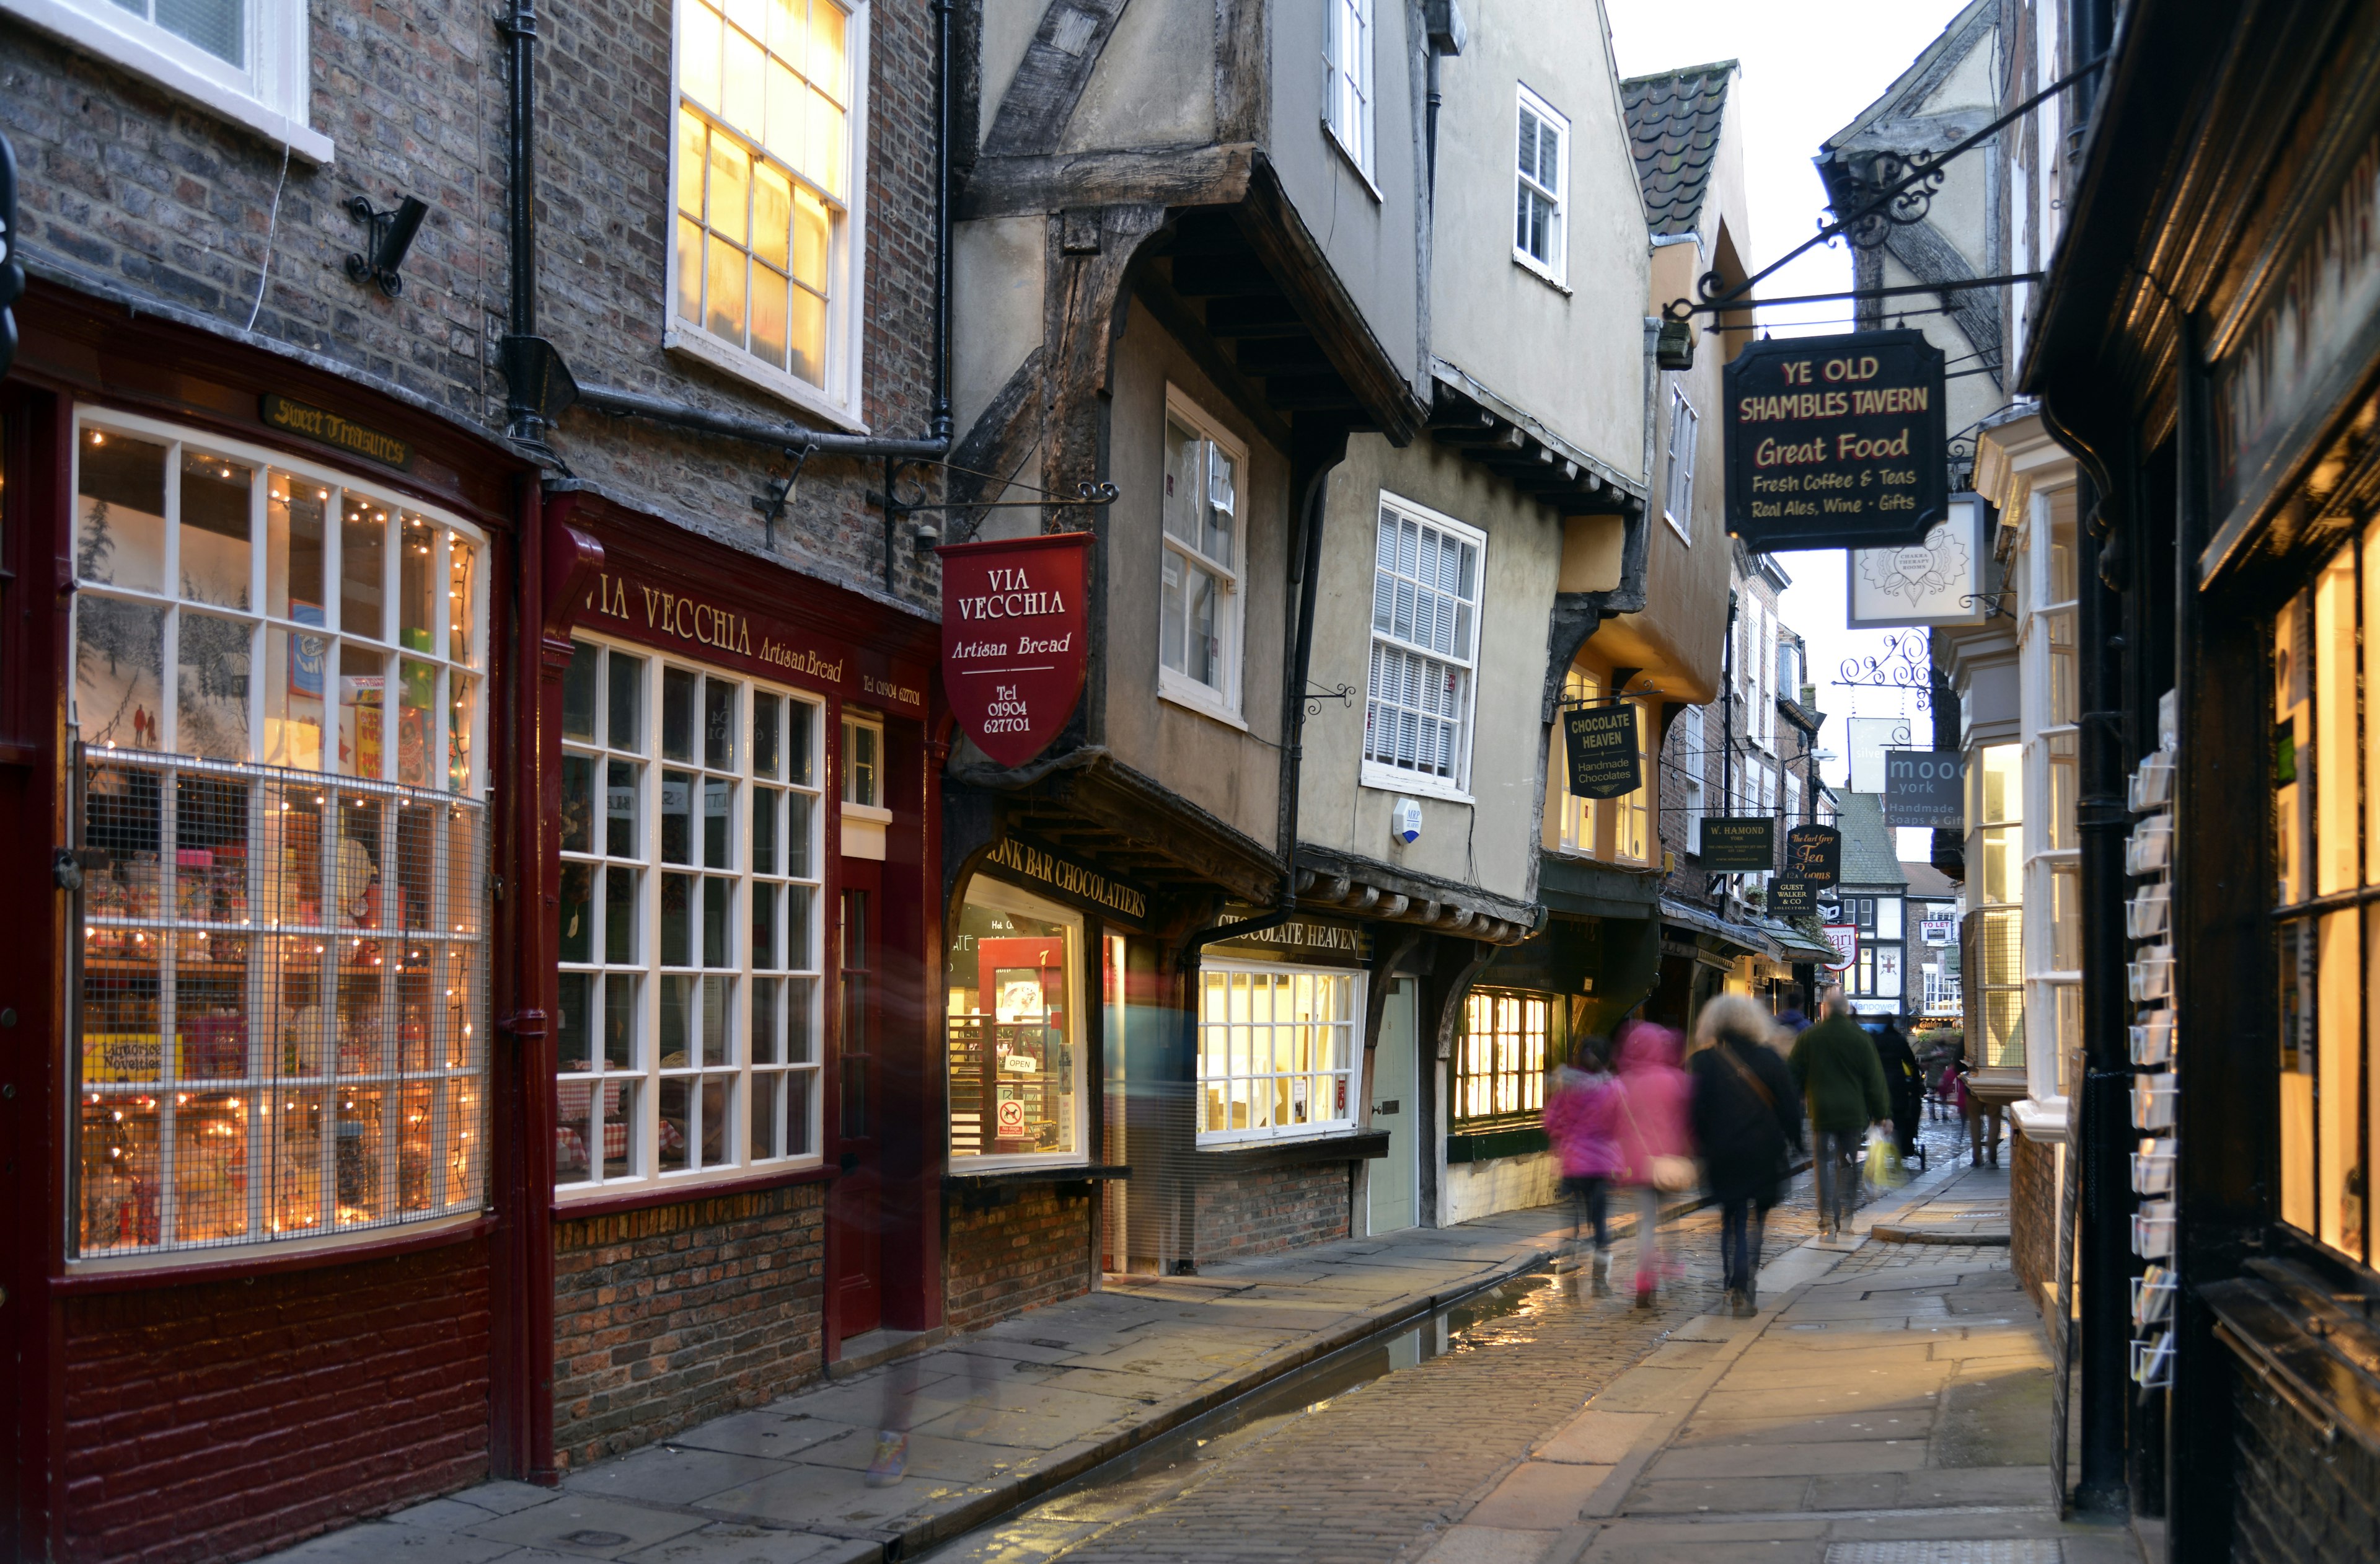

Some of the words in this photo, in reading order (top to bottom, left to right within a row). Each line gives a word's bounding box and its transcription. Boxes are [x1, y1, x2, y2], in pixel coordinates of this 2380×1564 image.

[1782, 361, 1812, 385] YE
[1822, 357, 1879, 381] OLD
[1740, 391, 1848, 423] SHAMBLES
[1852, 387, 1928, 415] TAVERN
[274, 399, 323, 435] Sweet
[325, 414, 405, 464] Treasures
[1755, 436, 1828, 468] Great
[1838, 428, 1910, 460] Food
[1752, 475, 1799, 492] Fresh
[1804, 473, 1853, 490] Coffee
[1861, 469, 1872, 487] &
[1879, 469, 1917, 485] Teas
[1752, 501, 1781, 518] Real
[1784, 500, 1819, 516] Ales,
[1823, 498, 1862, 513] Wine
[1879, 493, 1916, 511] Gifts
[988, 568, 1029, 592] VIA
[958, 591, 1065, 620] VECCHIA
[586, 573, 629, 619] IA
[643, 585, 752, 656] VECCHIA
[759, 637, 804, 671] Artisan
[805, 649, 844, 683] Bread
[951, 641, 1007, 658] Artisan
[1017, 632, 1072, 655] Bread
[863, 674, 874, 692] Tel
[876, 681, 897, 699] 01904
[899, 687, 920, 706] 627701
[997, 684, 1017, 702] Tel
[988, 700, 1027, 717] 01904
[984, 718, 1031, 733] 627701
[1571, 713, 1630, 733] CHOCOLATE
[1582, 731, 1622, 749] HEAVEN
[1578, 758, 1629, 772] Handmade
[1579, 771, 1631, 784] Chocolates
[1408, 810, 1420, 820] MRP
[1889, 803, 1954, 813] Handmade
[1889, 815, 1924, 826] Soaps
[1930, 816, 1938, 824] &
[1711, 826, 1721, 834] W.
[1724, 826, 1764, 834] HAMOND
[1791, 833, 1802, 842] The
[1804, 833, 1817, 842] Earl
[1818, 834, 1834, 844] Grey
[1796, 842, 1825, 864] Tea
[1025, 846, 1052, 883] BAR
[1056, 859, 1145, 918] CHOCOLATIERS
[992, 921, 1003, 929] Hot
[1307, 924, 1358, 950] HEAVEN
[1039, 950, 1049, 966] 7
[1850, 1001, 1896, 1012] Manpower
[102, 1043, 161, 1058] Liquorice
[104, 1056, 161, 1071] Novelties
[1010, 1059, 1030, 1068] OPEN
